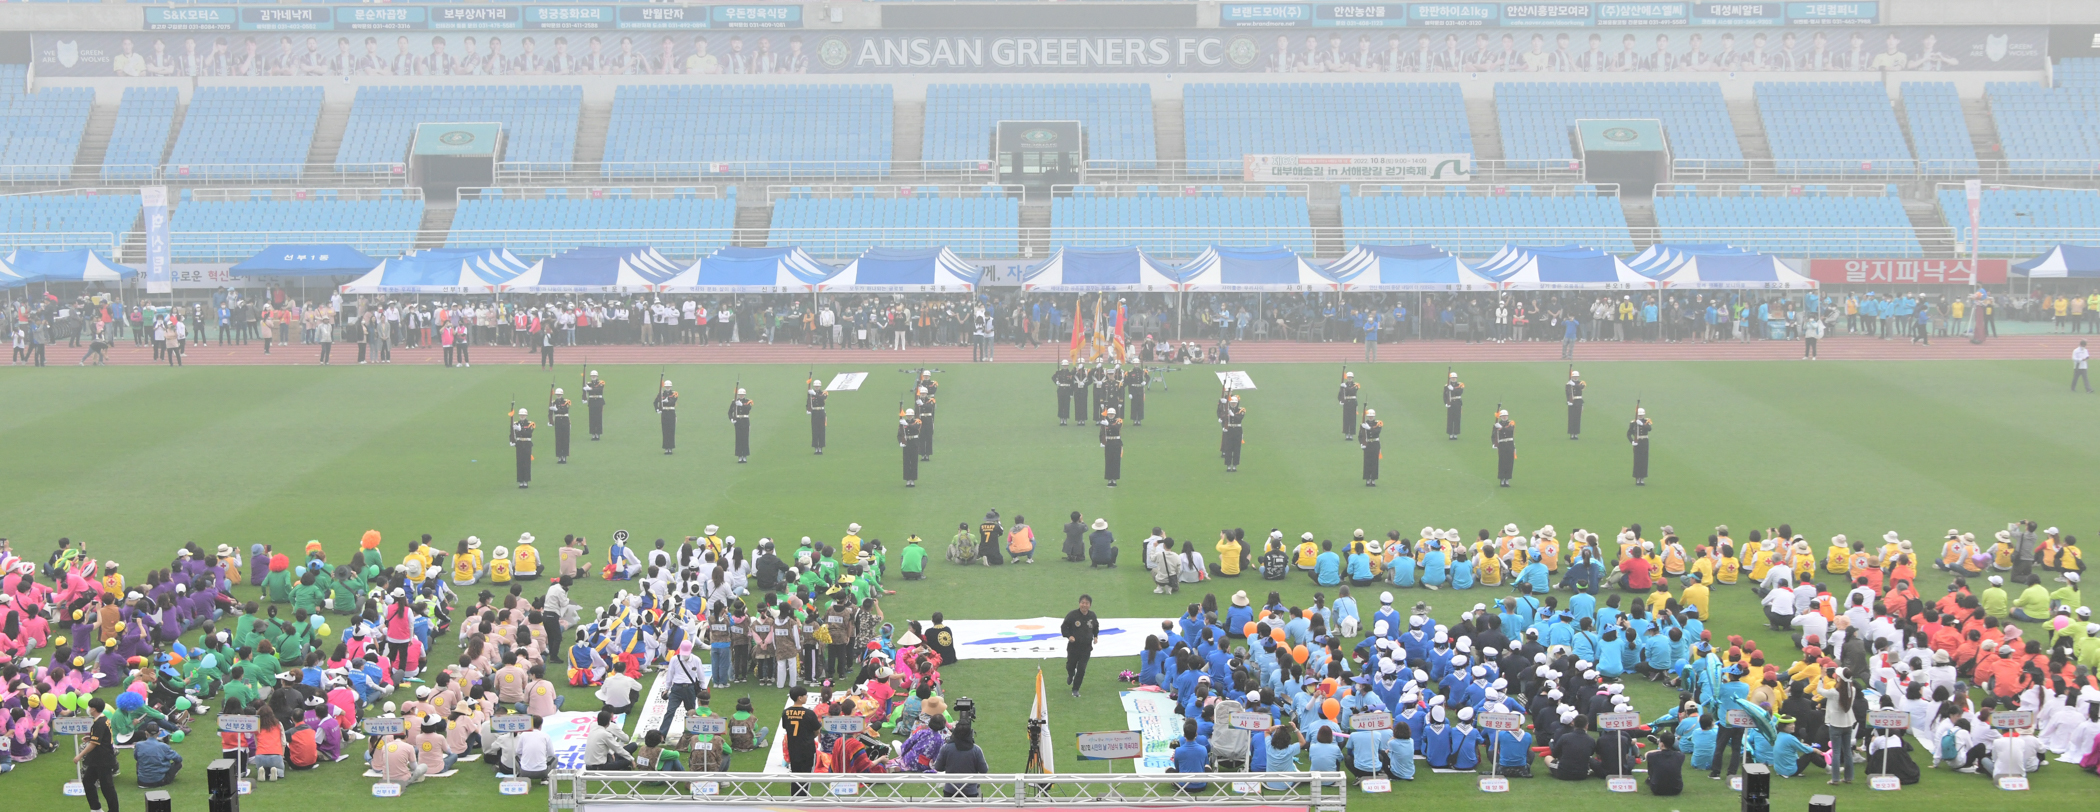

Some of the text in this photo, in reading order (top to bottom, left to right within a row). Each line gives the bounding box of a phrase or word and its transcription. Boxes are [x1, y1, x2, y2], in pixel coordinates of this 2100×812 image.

[163, 9, 220, 20] S&K모터스
[260, 9, 313, 21] 김가네낙지
[355, 8, 408, 20] 문순자곱창
[444, 8, 507, 20] 보부상사거리
[642, 7, 685, 20] 반월단자
[726, 8, 788, 20] 우돈정육식당
[1231, 6, 1301, 19] 브랜드모아(주)
[1333, 6, 1385, 18] 안산농산물
[1507, 5, 1589, 17] 안산시흥맘모여라
[1710, 5, 1763, 16] 대성씨알티
[1805, 5, 1858, 16] 그린컴퍼니
[856, 37, 1221, 67] ANSAN GREENERS FC
[1328, 166, 1338, 176] in
[1384, 166, 1427, 176] 걷기축제
[284, 254, 329, 262] 선부1동
[171, 270, 202, 282] 유로운
[1844, 260, 1971, 283] 알지파낙스
[1286, 284, 1313, 292] 사이동
[984, 531, 991, 543] 7
[785, 709, 806, 717] STAFF
[225, 722, 252, 730] 선부2동
[498, 722, 525, 730] 백운동
[830, 723, 857, 731] 원곡동
[1239, 720, 1261, 729] 사동
[1358, 720, 1385, 729] 사이동
[1485, 720, 1512, 729] 해양동
[1605, 720, 1633, 728] 본오1동
[1874, 719, 1902, 727] 본오3동
[1998, 718, 2025, 726] 반월동
[370, 725, 398, 733] 선부1동
[692, 724, 719, 732] 신길동
[790, 720, 800, 737] 7
[1107, 743, 1119, 751] 기념식
